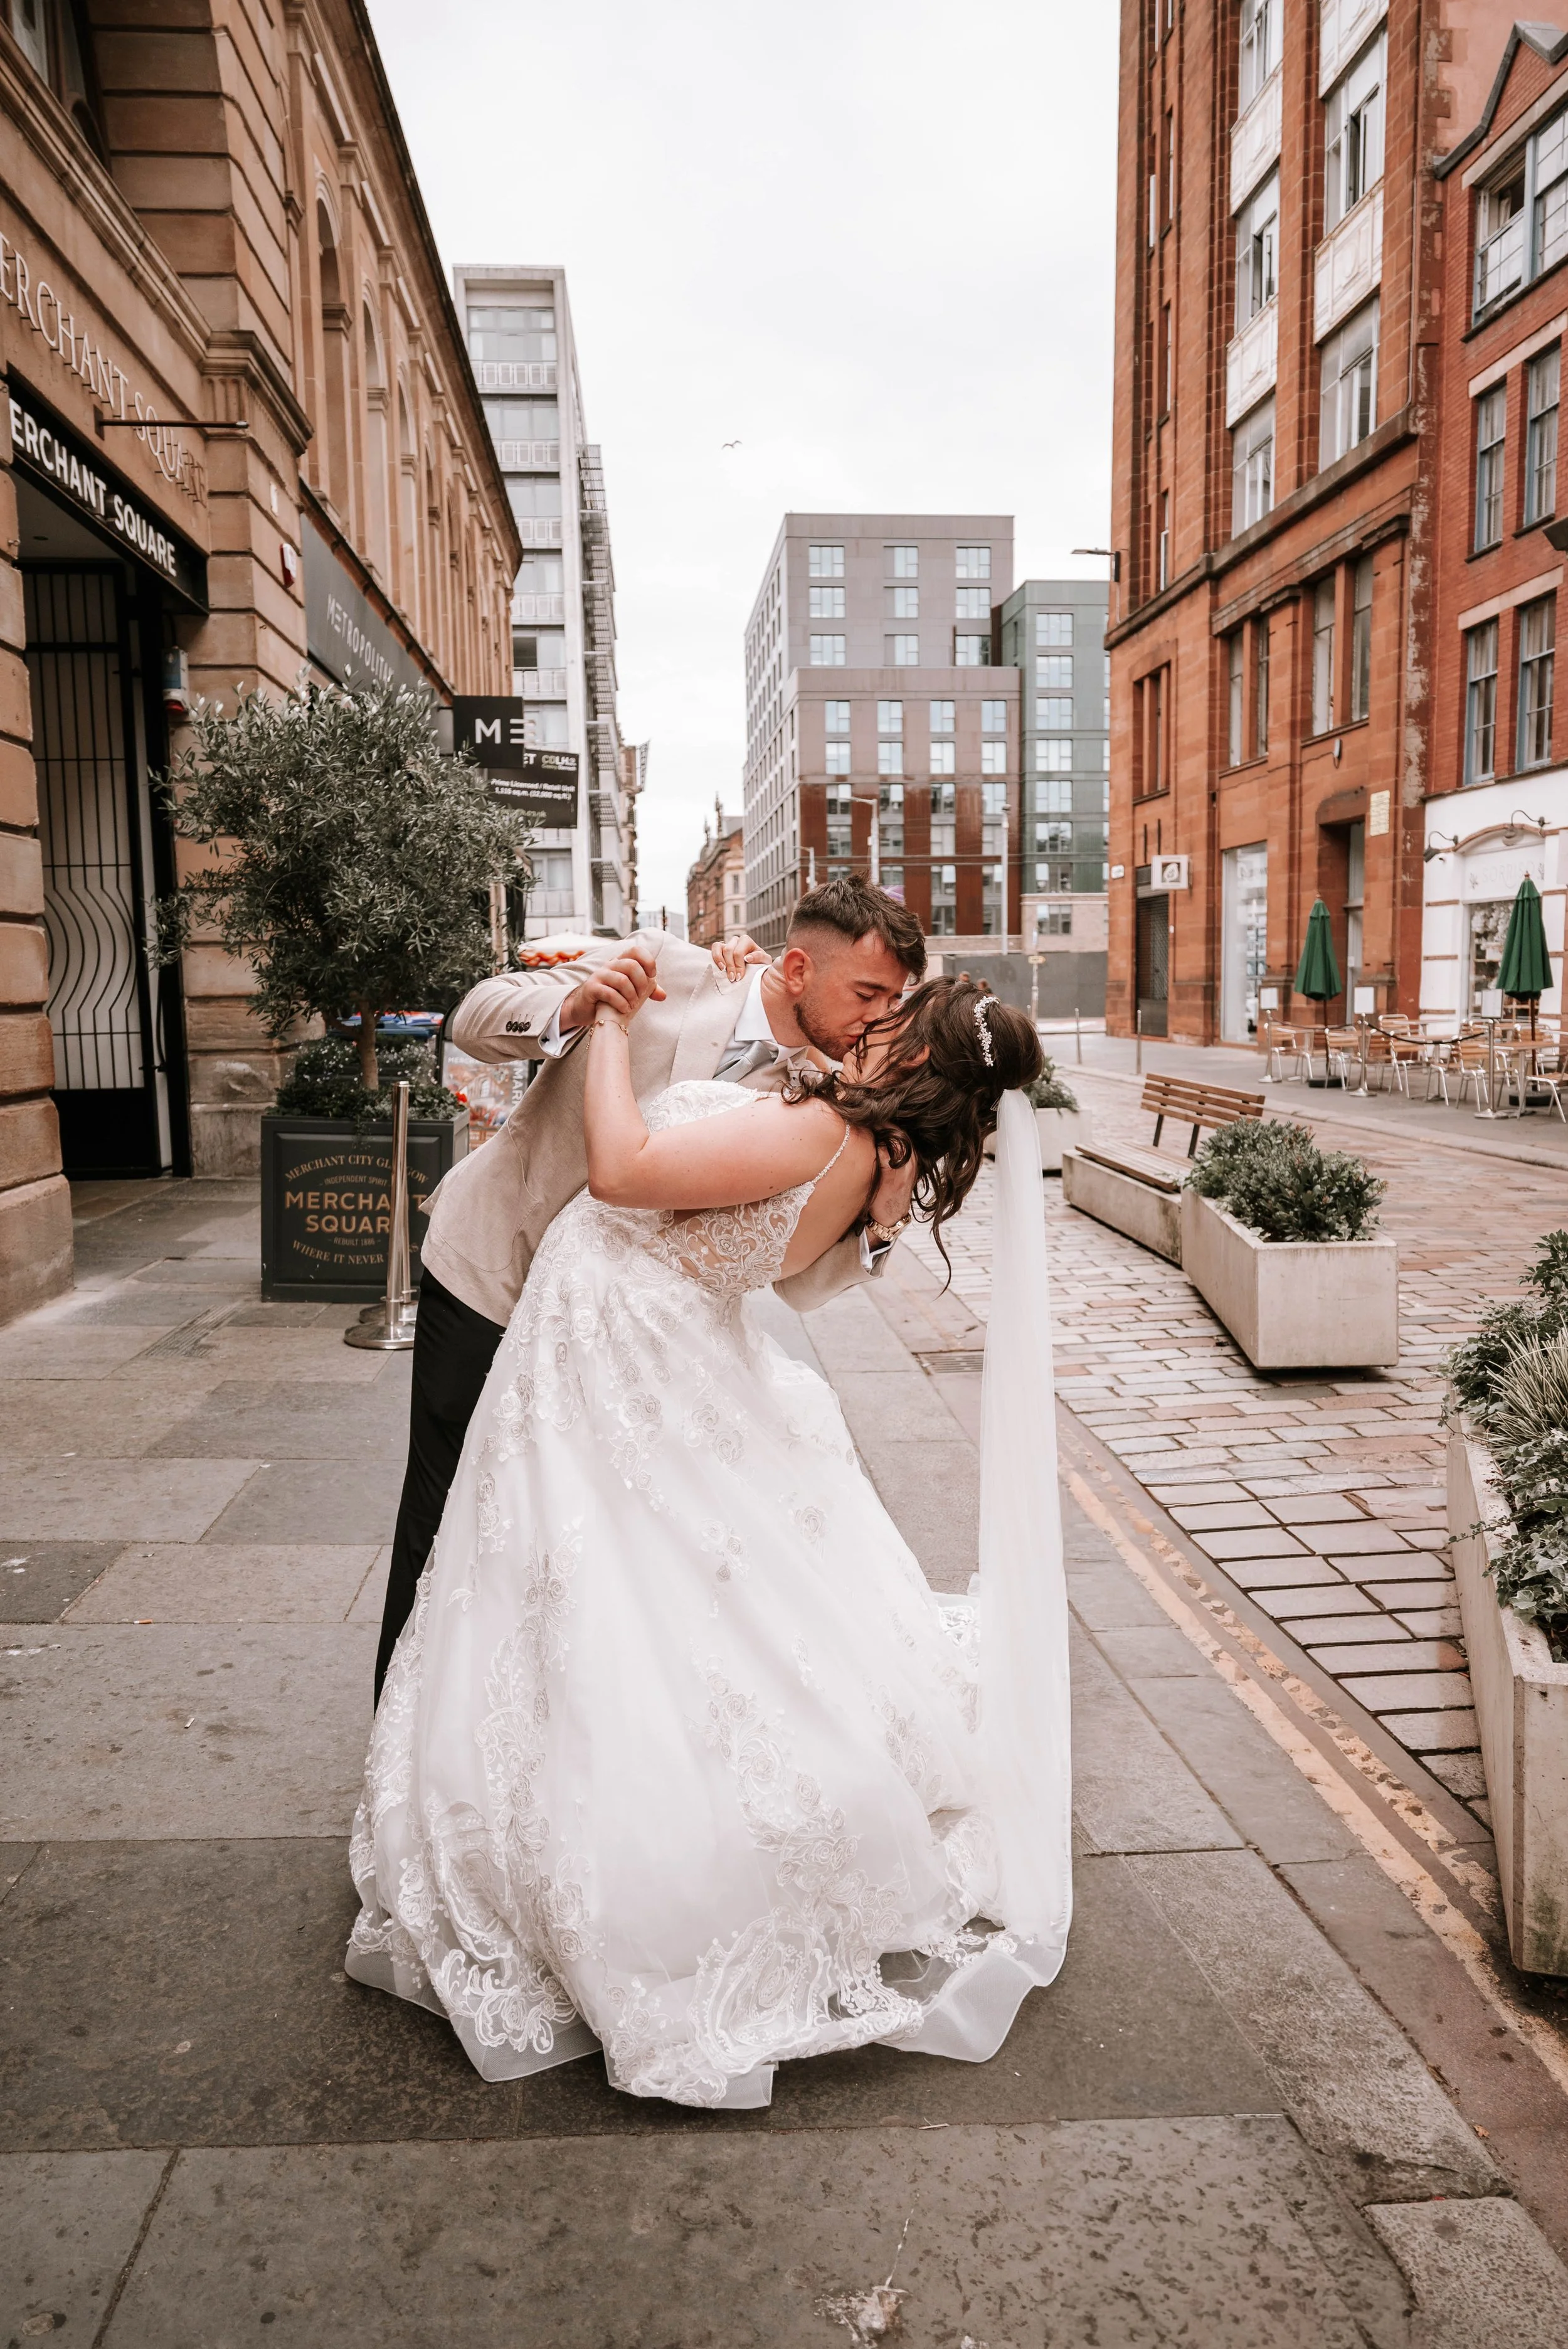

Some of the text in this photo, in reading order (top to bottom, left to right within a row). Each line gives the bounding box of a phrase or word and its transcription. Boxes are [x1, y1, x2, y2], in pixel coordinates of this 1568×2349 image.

[0, 231, 128, 420] ERCHANT
[9, 398, 177, 576] ERCHANT SQUARE
[285, 1155, 344, 1182] MERCHANT
[348, 1155, 374, 1165] CITY
[324, 1175, 388, 1187] INDEPENDENT SPIRIT
[285, 1192, 427, 1212] MERCHAT
[305, 1214, 390, 1234] SQUAR
[292, 1240, 384, 1265] WHERE IT NEVER
[334, 1237, 358, 1246] REBUILT
